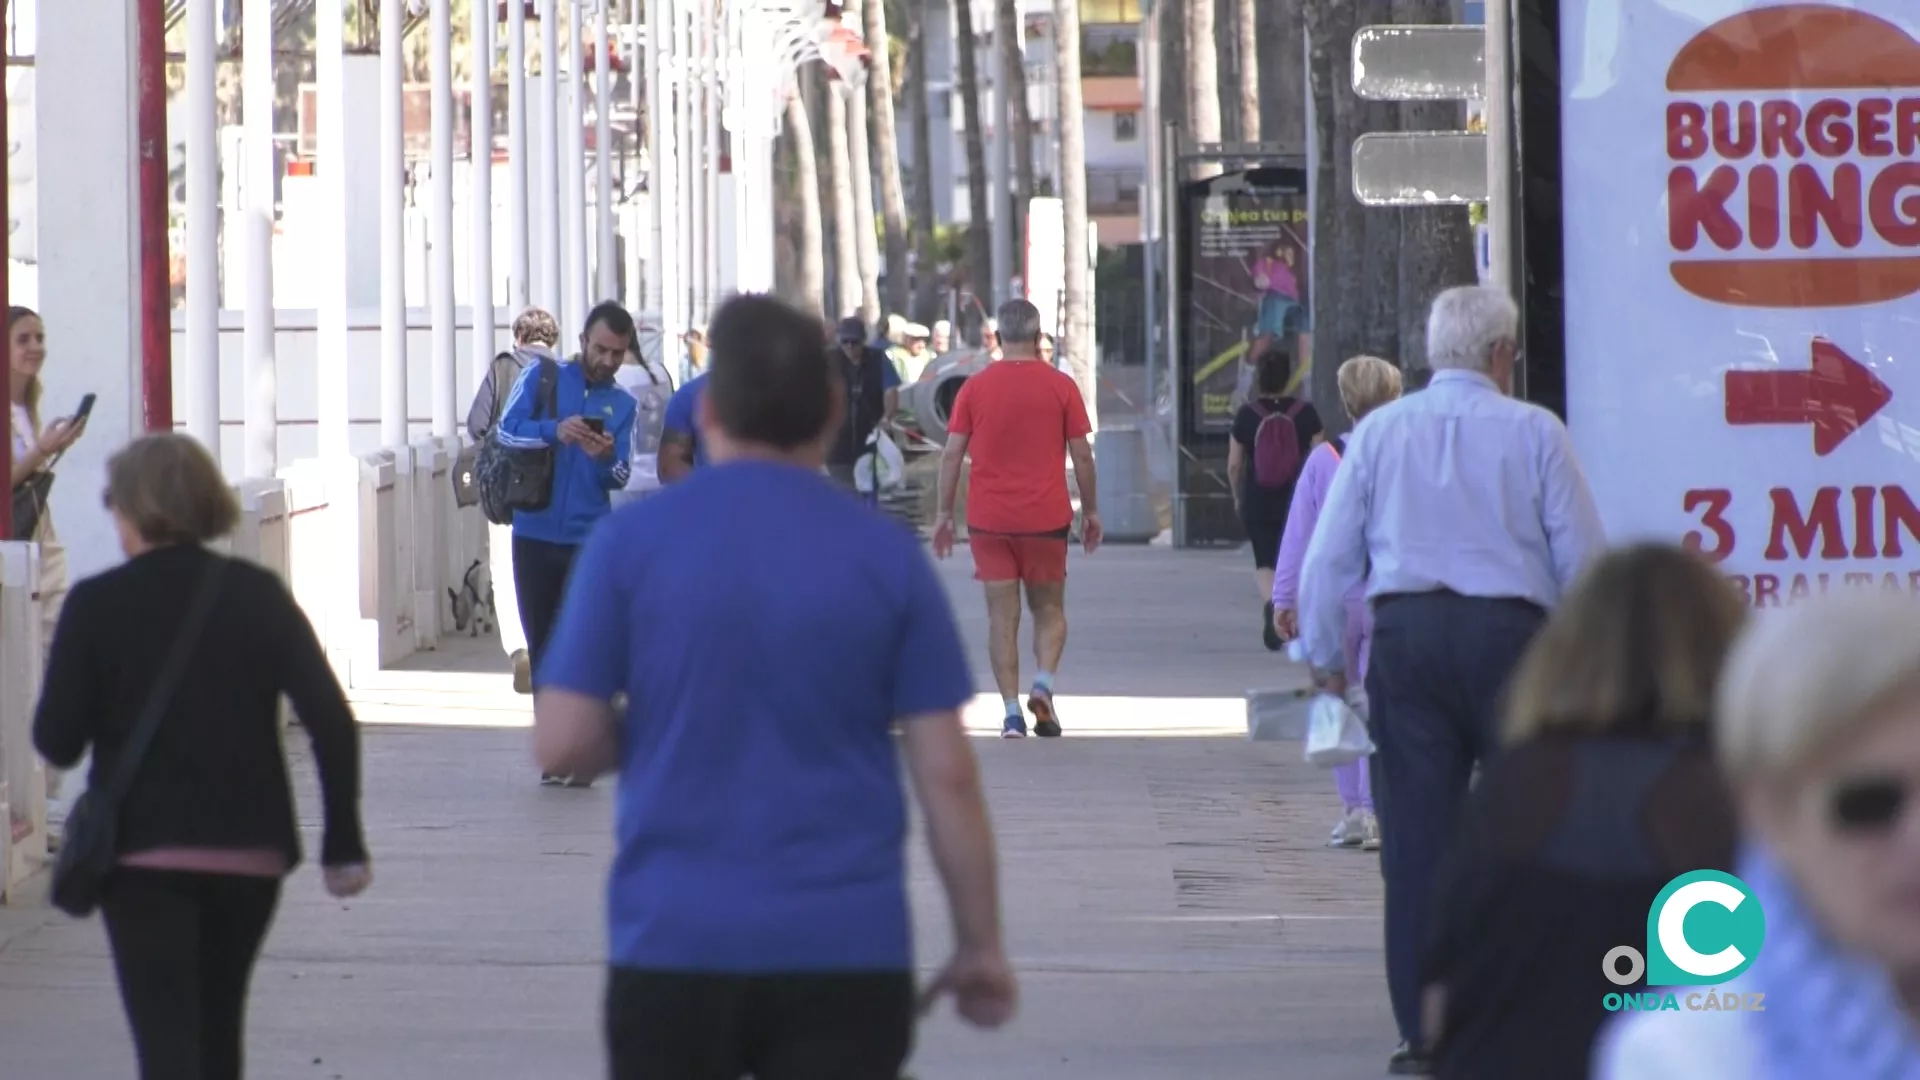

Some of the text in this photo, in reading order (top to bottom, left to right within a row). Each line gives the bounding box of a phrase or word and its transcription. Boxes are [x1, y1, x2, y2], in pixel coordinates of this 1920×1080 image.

[1666, 98, 1920, 160] BURGER
[1668, 162, 1920, 251] KING
[1683, 488, 1735, 564] 3
